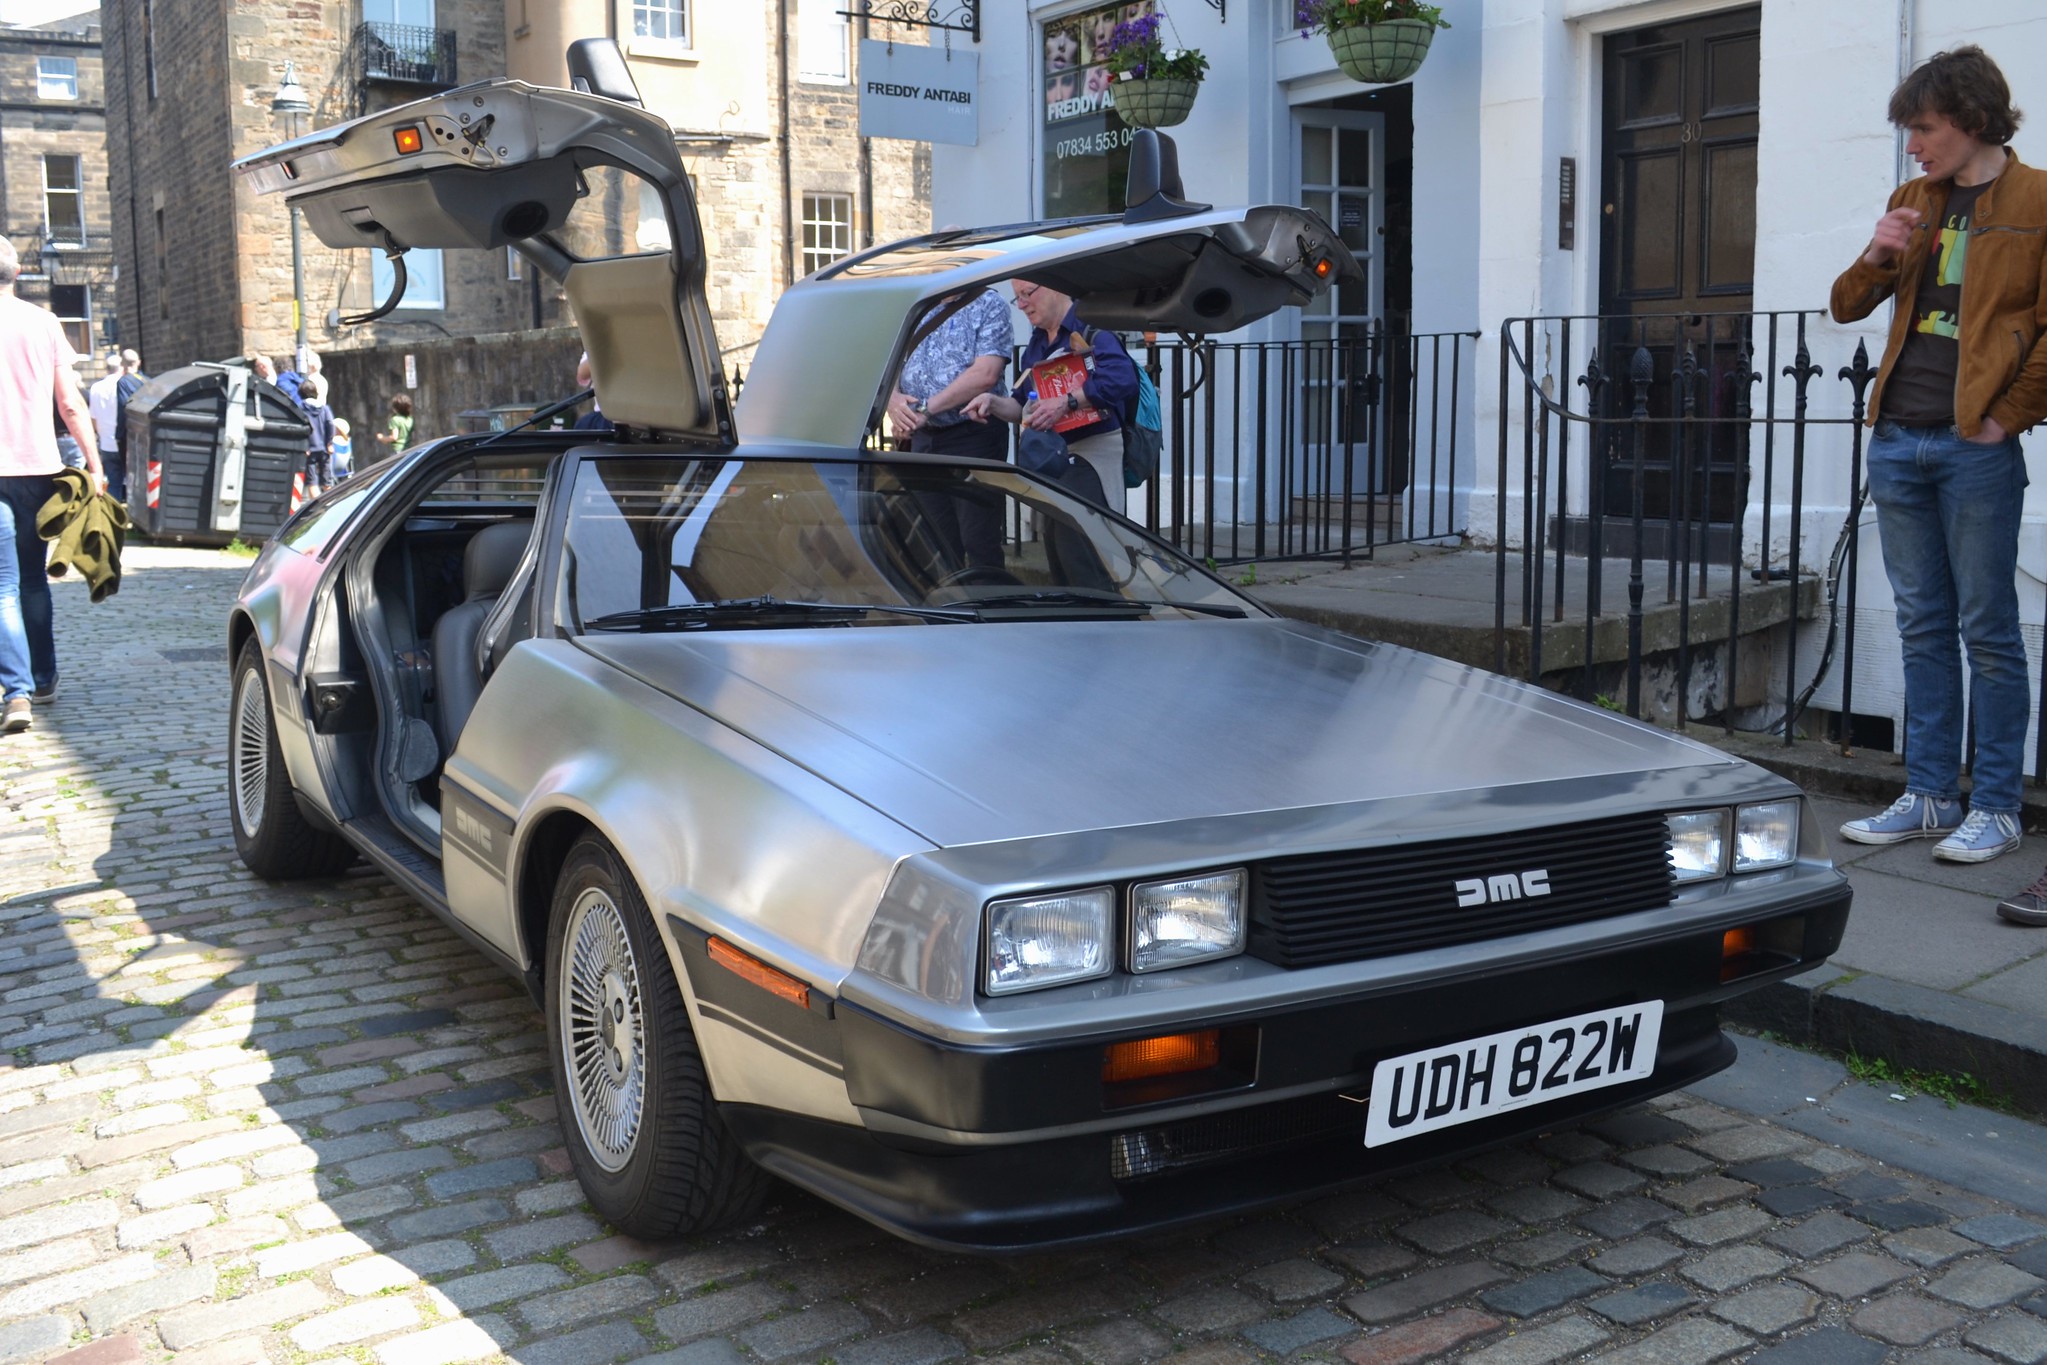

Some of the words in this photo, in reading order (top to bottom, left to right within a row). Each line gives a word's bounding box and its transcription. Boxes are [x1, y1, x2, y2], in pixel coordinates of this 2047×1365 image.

[867, 81, 920, 99] FREDDY
[923, 87, 971, 104] ANTABI
[947, 105, 971, 116] HAIR
[1047, 95, 1098, 121] FREDDY
[1681, 121, 1702, 143] 30
[1056, 136, 1092, 160] 07834
[1095, 130, 1118, 152] 553
[1387, 1044, 1498, 1129] UDH
[1508, 1013, 1642, 1098] 822W
